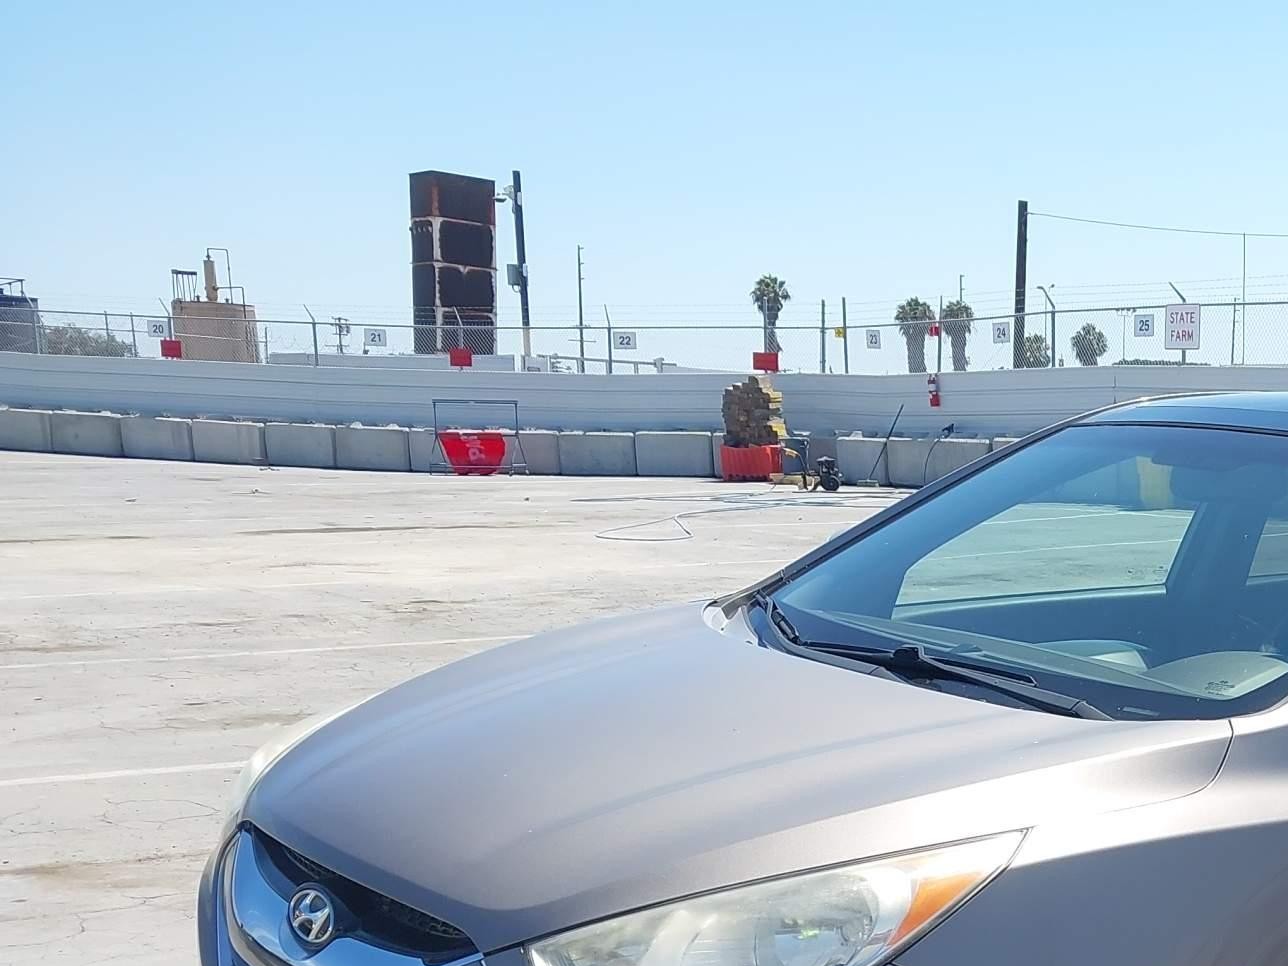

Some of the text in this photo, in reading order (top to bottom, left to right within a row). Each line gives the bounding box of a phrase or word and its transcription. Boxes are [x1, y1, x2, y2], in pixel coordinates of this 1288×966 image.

[1169, 311, 1196, 324] STATE
[152, 324, 164, 335] 20
[1138, 319, 1150, 332] 25
[370, 332, 382, 343] 21
[996, 327, 1006, 339] 24
[1170, 330, 1194, 342] FARM
[619, 335, 632, 346] 22
[869, 334, 878, 345] 23
